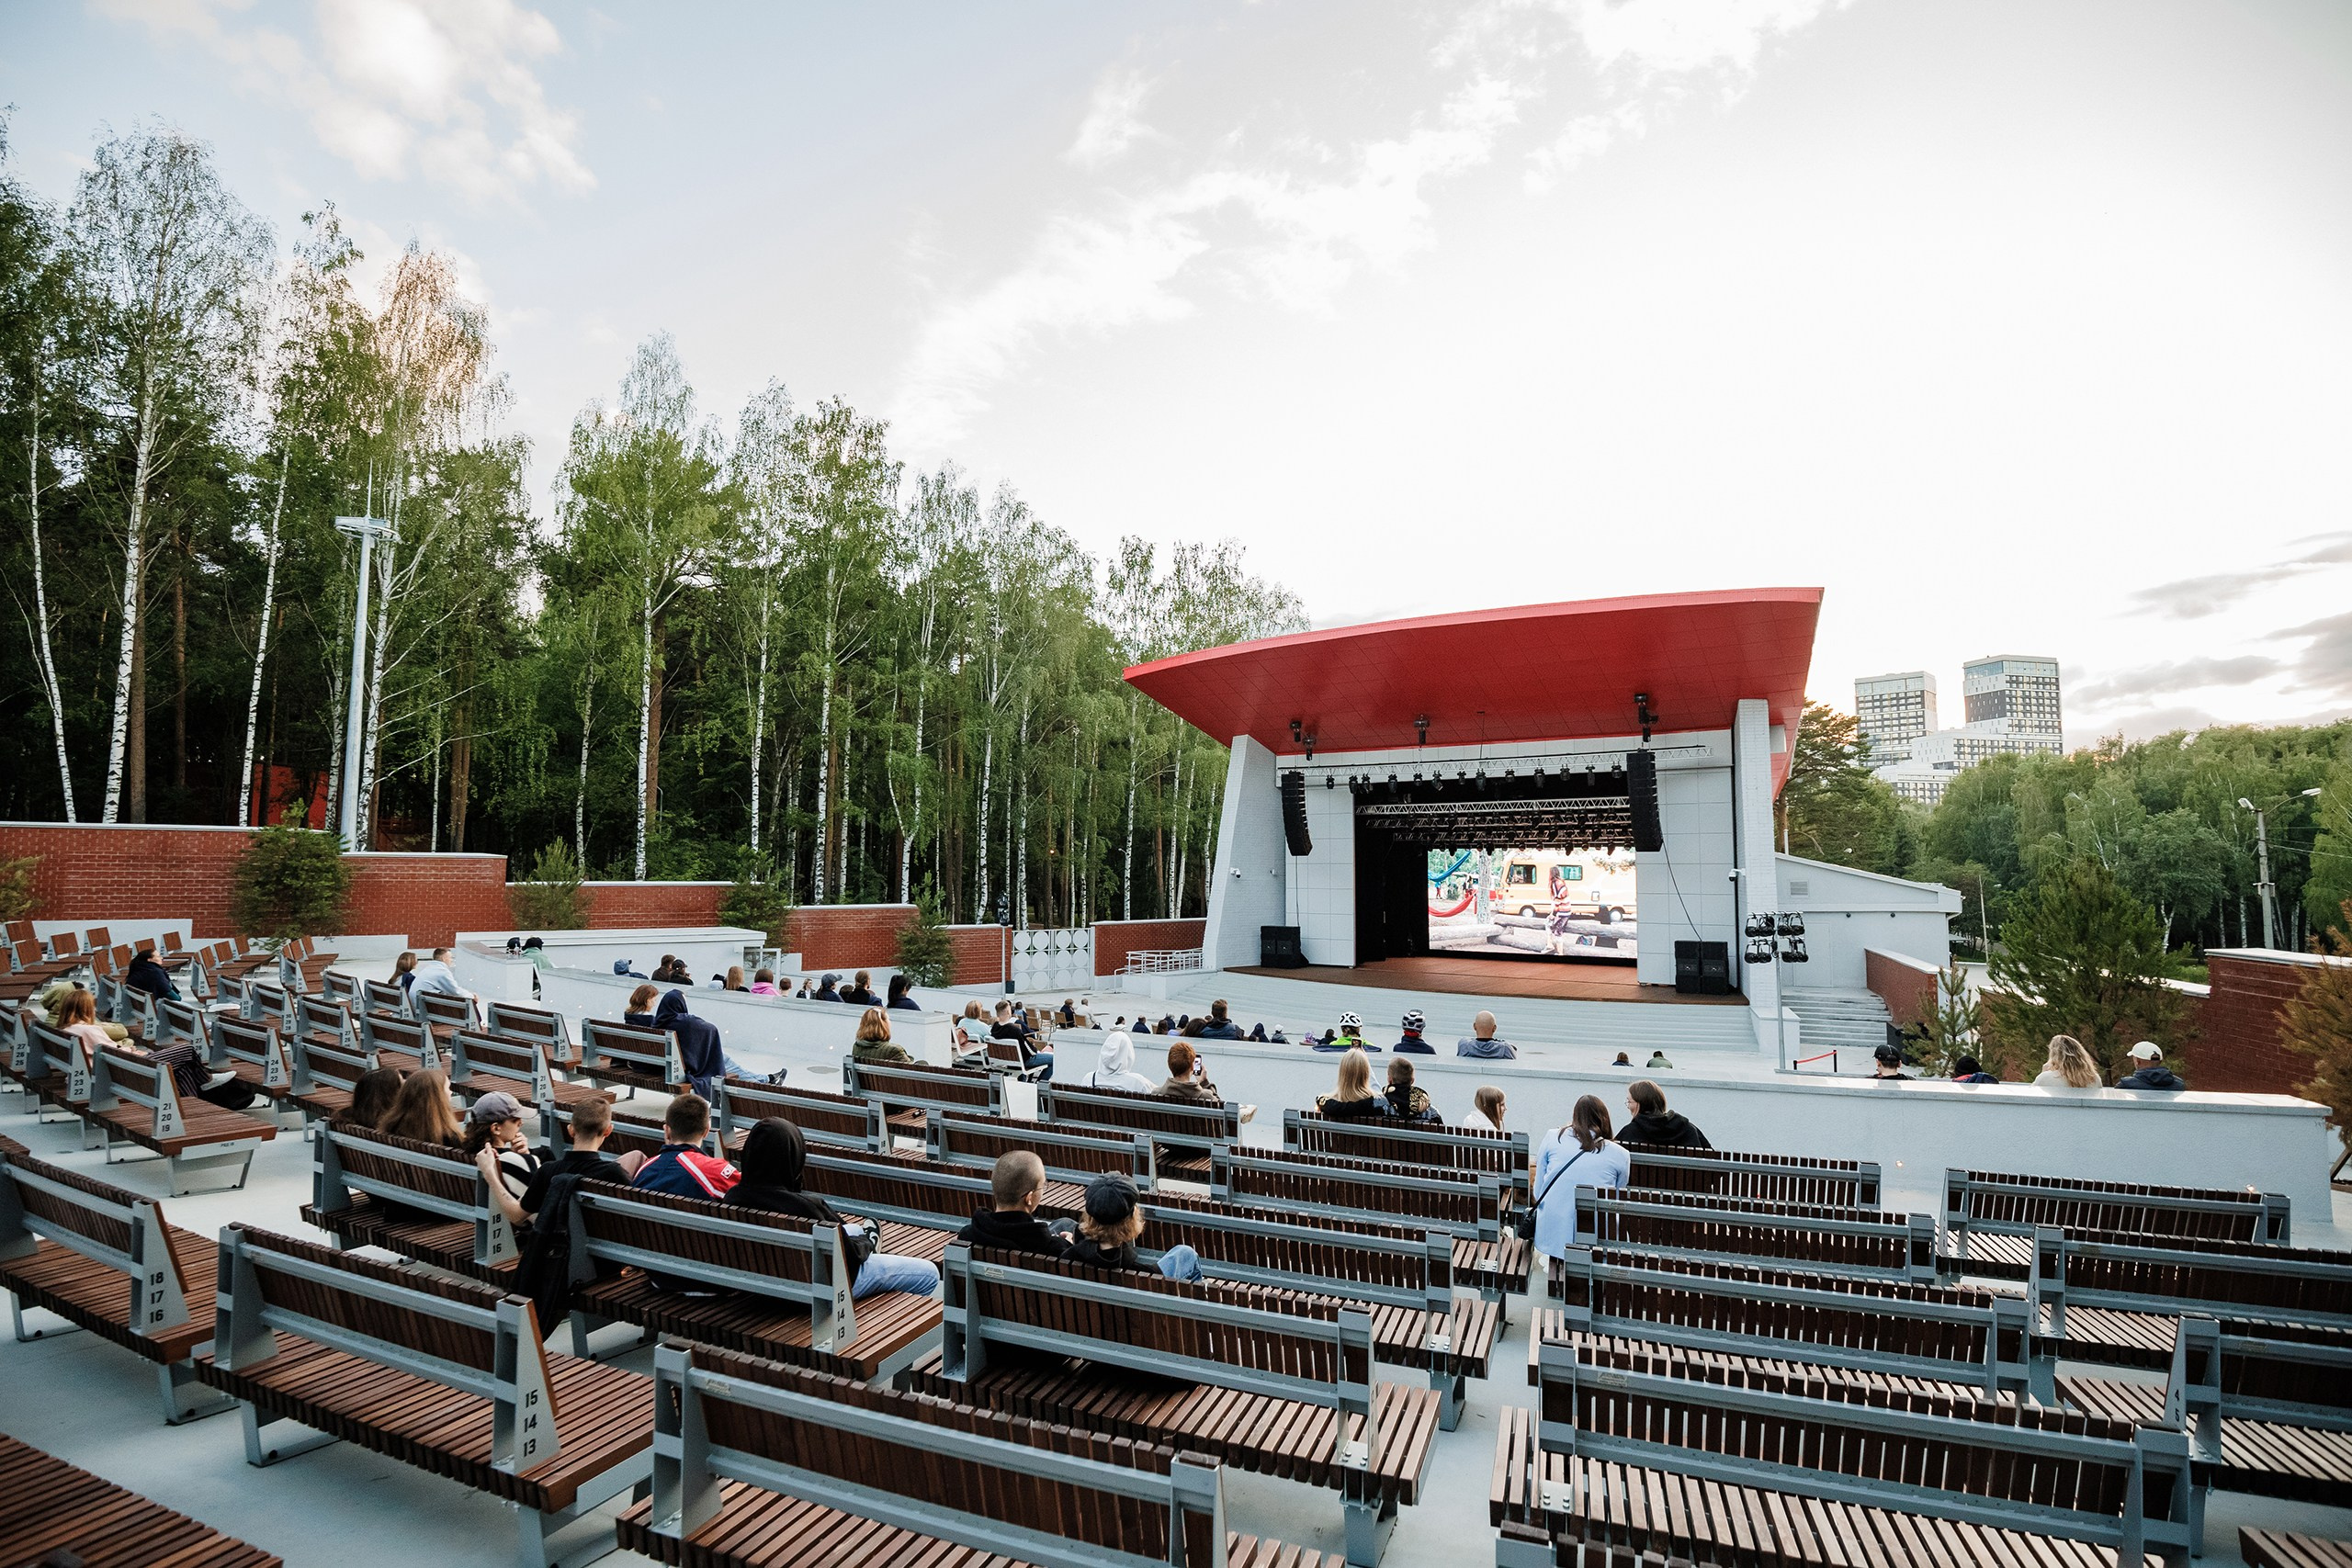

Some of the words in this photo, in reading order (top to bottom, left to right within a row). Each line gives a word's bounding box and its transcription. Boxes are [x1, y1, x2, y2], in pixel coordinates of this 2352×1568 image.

[163, 1102, 172, 1111] 21
[161, 1113, 172, 1122] 20
[162, 1124, 170, 1133] 19
[492, 1213, 502, 1224] 18
[492, 1228, 502, 1239] 17
[492, 1243, 503, 1255] 16
[150, 1271, 164, 1286] 18
[151, 1290, 164, 1304] 17
[837, 1289, 845, 1304] 15
[150, 1309, 164, 1324] 16
[837, 1308, 845, 1323] 14
[837, 1326, 845, 1340] 13
[525, 1389, 538, 1408] 15
[2174, 1389, 2180, 1402] 4
[2175, 1408, 2180, 1422] 5
[524, 1414, 537, 1433] 14
[523, 1438, 537, 1458] 13
